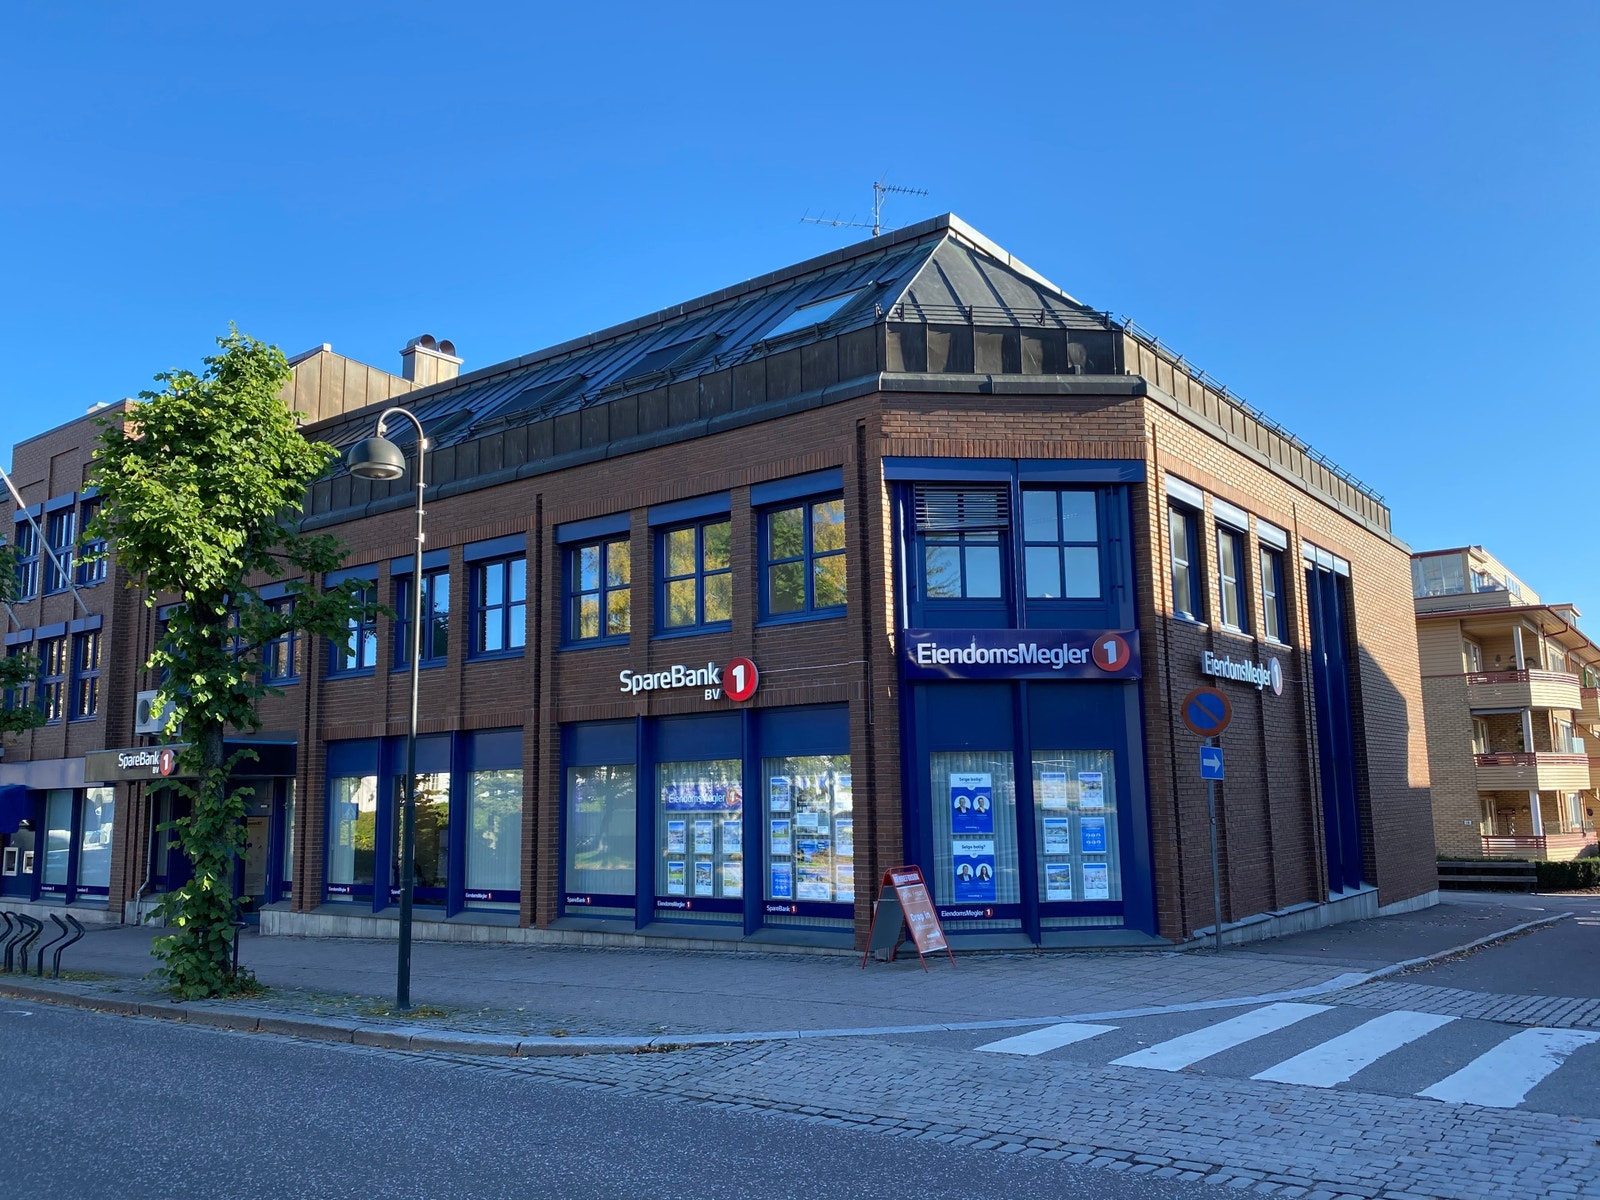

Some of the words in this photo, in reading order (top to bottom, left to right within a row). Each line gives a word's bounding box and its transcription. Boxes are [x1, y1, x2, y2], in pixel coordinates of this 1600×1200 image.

[917, 642, 1089, 669] EiendomsMegler
[1103, 640, 1118, 664] 1
[619, 661, 721, 695] SpareBank
[732, 664, 745, 693] 1
[1202, 650, 1271, 690] EiendomsMegler
[704, 688, 721, 700] BV
[118, 750, 160, 769] SpareBank
[766, 904, 790, 912] SpareBank
